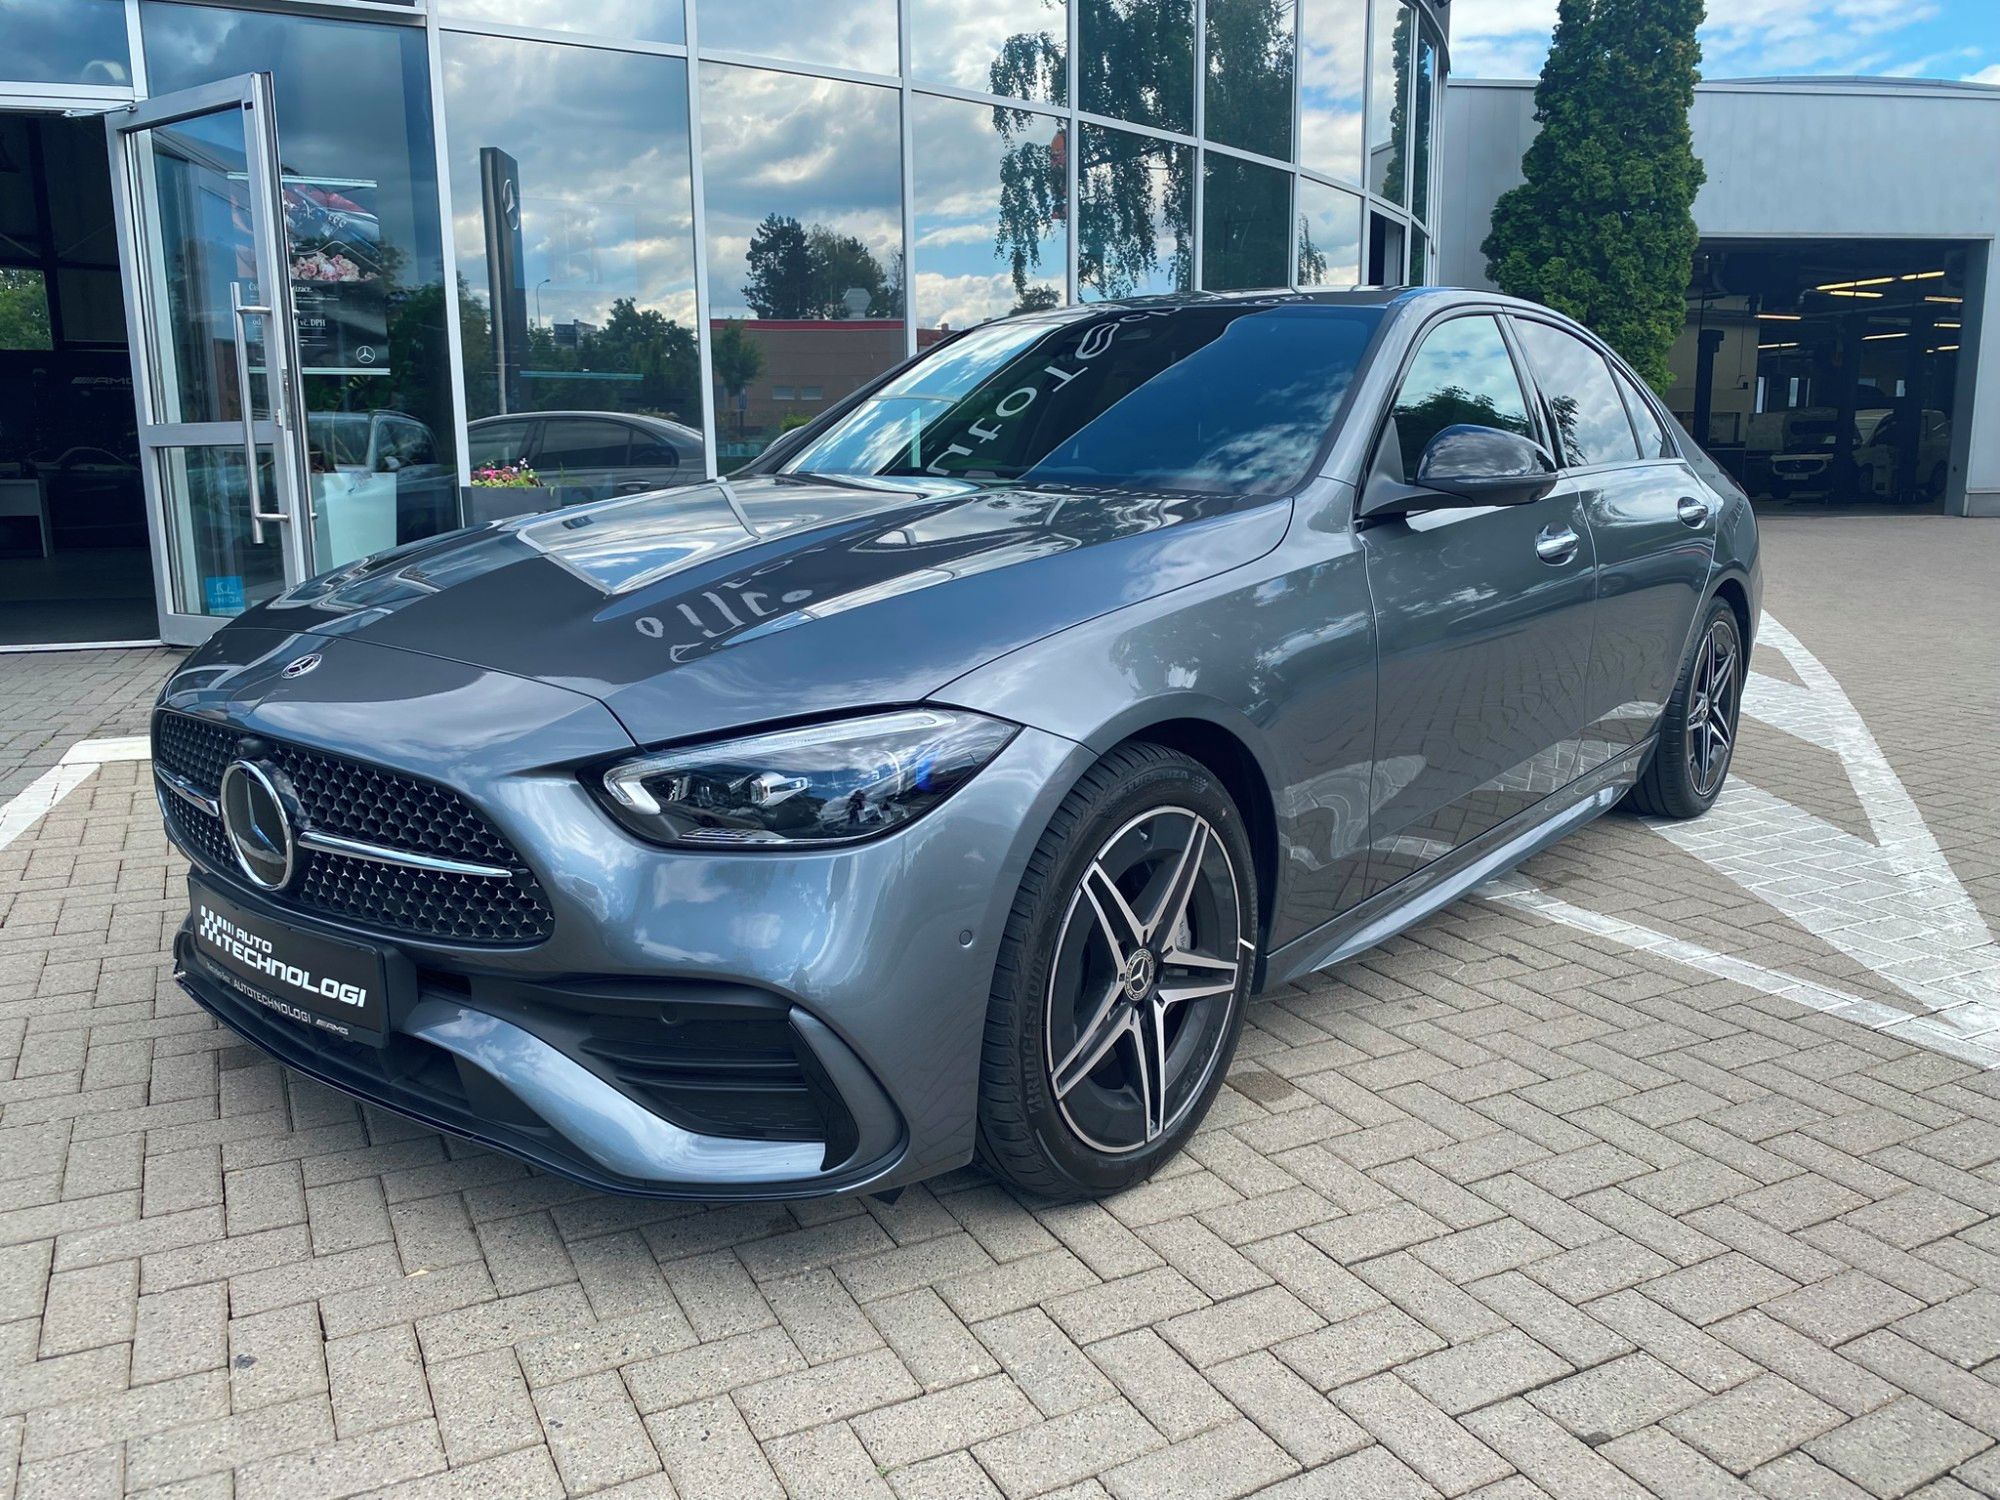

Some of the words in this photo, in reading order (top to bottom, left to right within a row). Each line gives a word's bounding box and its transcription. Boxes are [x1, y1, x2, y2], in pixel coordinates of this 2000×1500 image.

[310, 318, 326, 327] DPH
[237, 927, 272, 953] AUTO
[222, 933, 367, 1008] TECHNOLOGI
[234, 979, 311, 1024] AUTOTECHNOLOGI
[1021, 946, 1047, 1115] BRIDGESTONE
